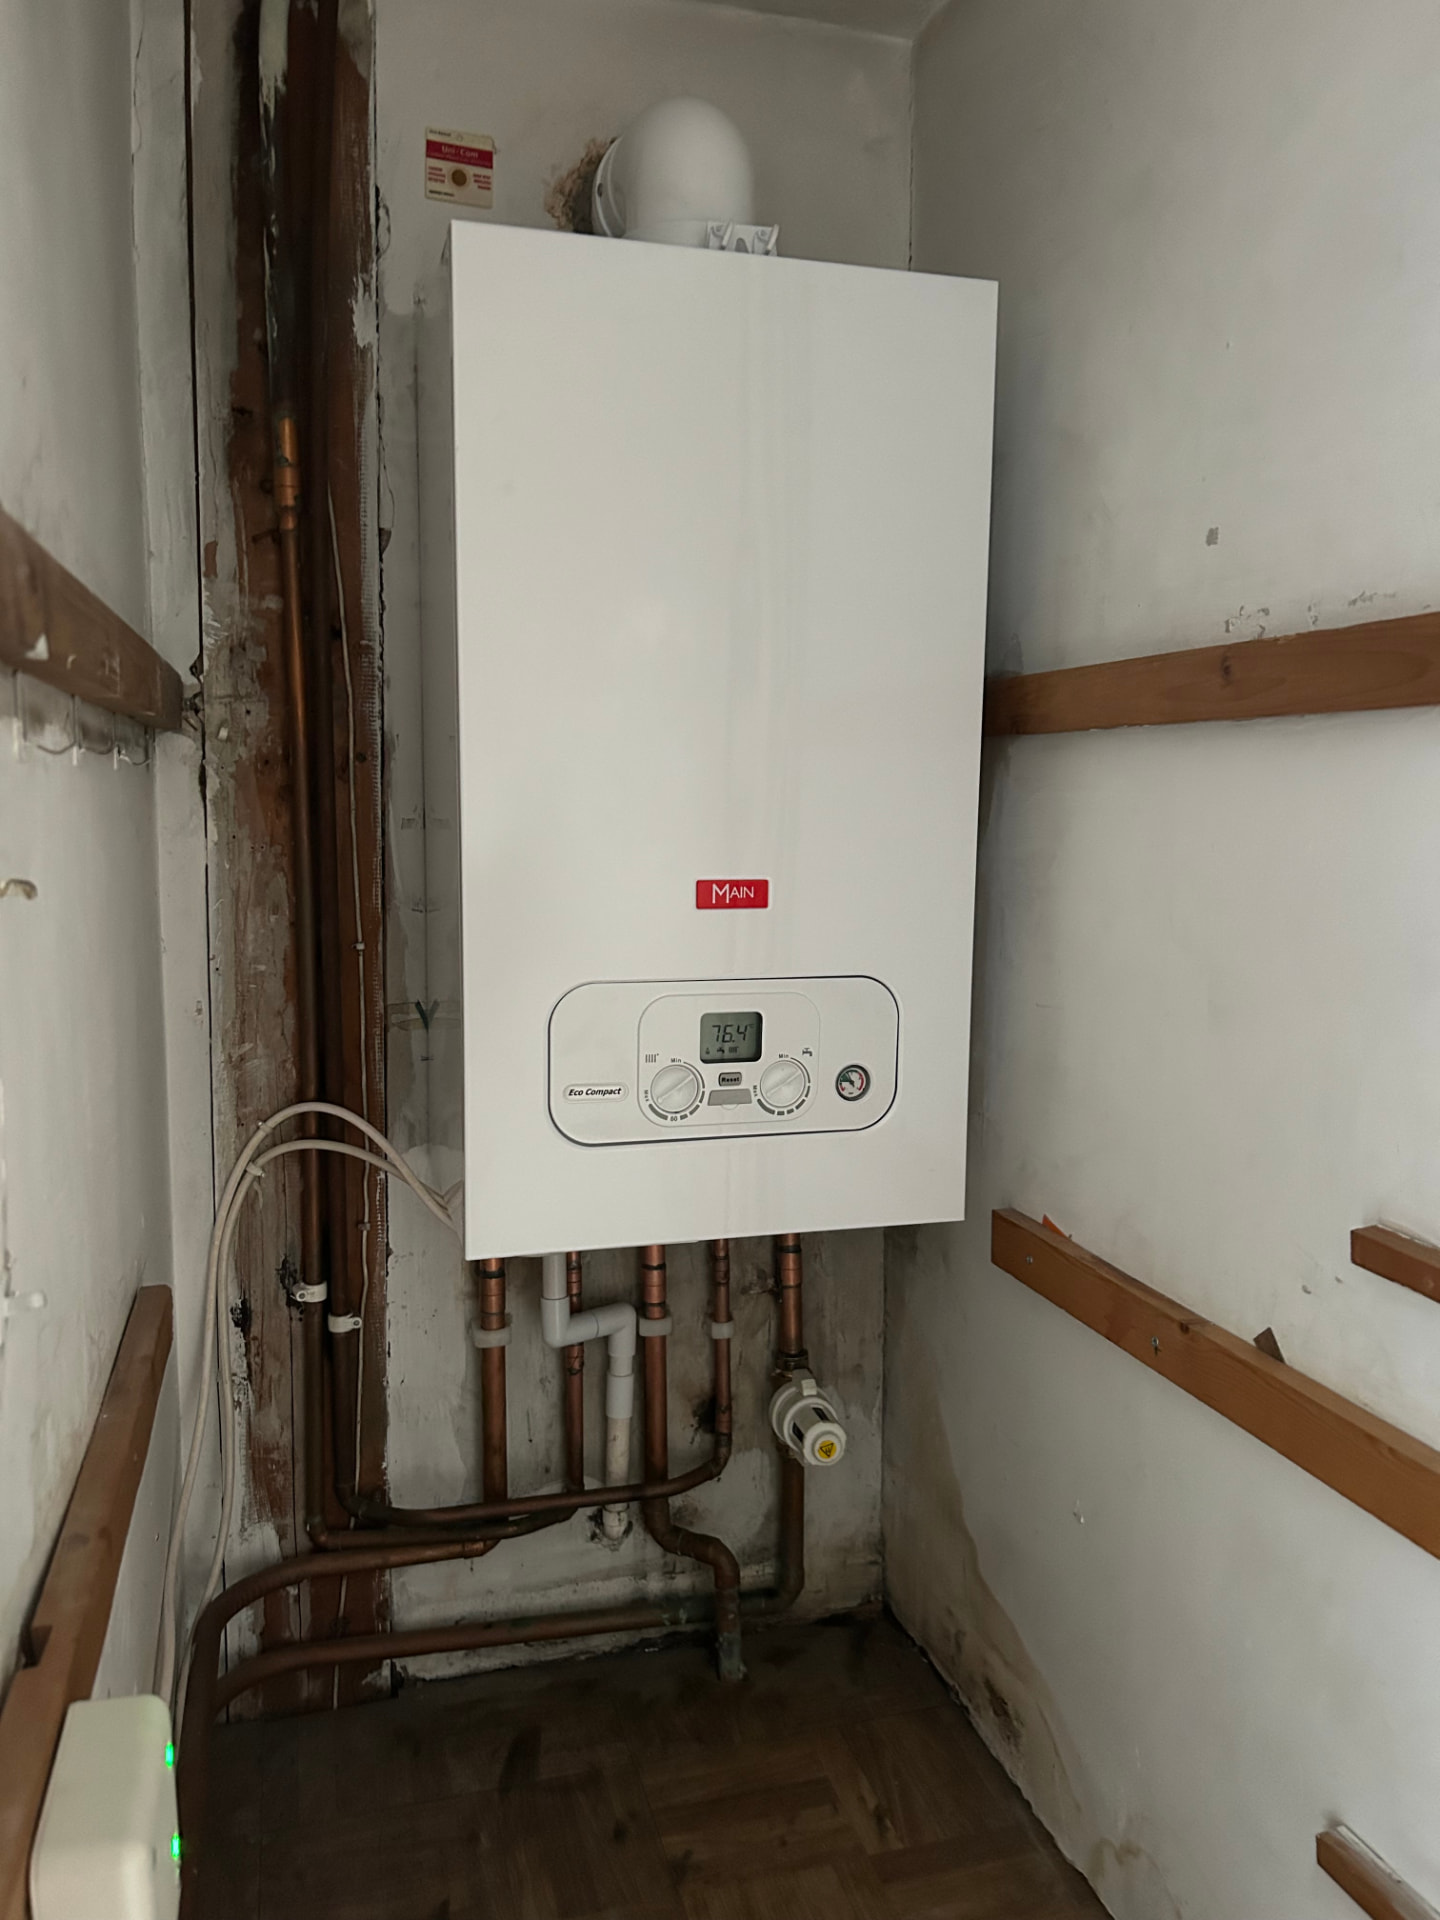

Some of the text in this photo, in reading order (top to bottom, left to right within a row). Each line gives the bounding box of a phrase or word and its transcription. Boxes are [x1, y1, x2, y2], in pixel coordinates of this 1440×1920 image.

[711, 883, 755, 904] MAIN
[711, 1023, 748, 1043] 76.4
[568, 1087, 622, 1097] Eco Compact
